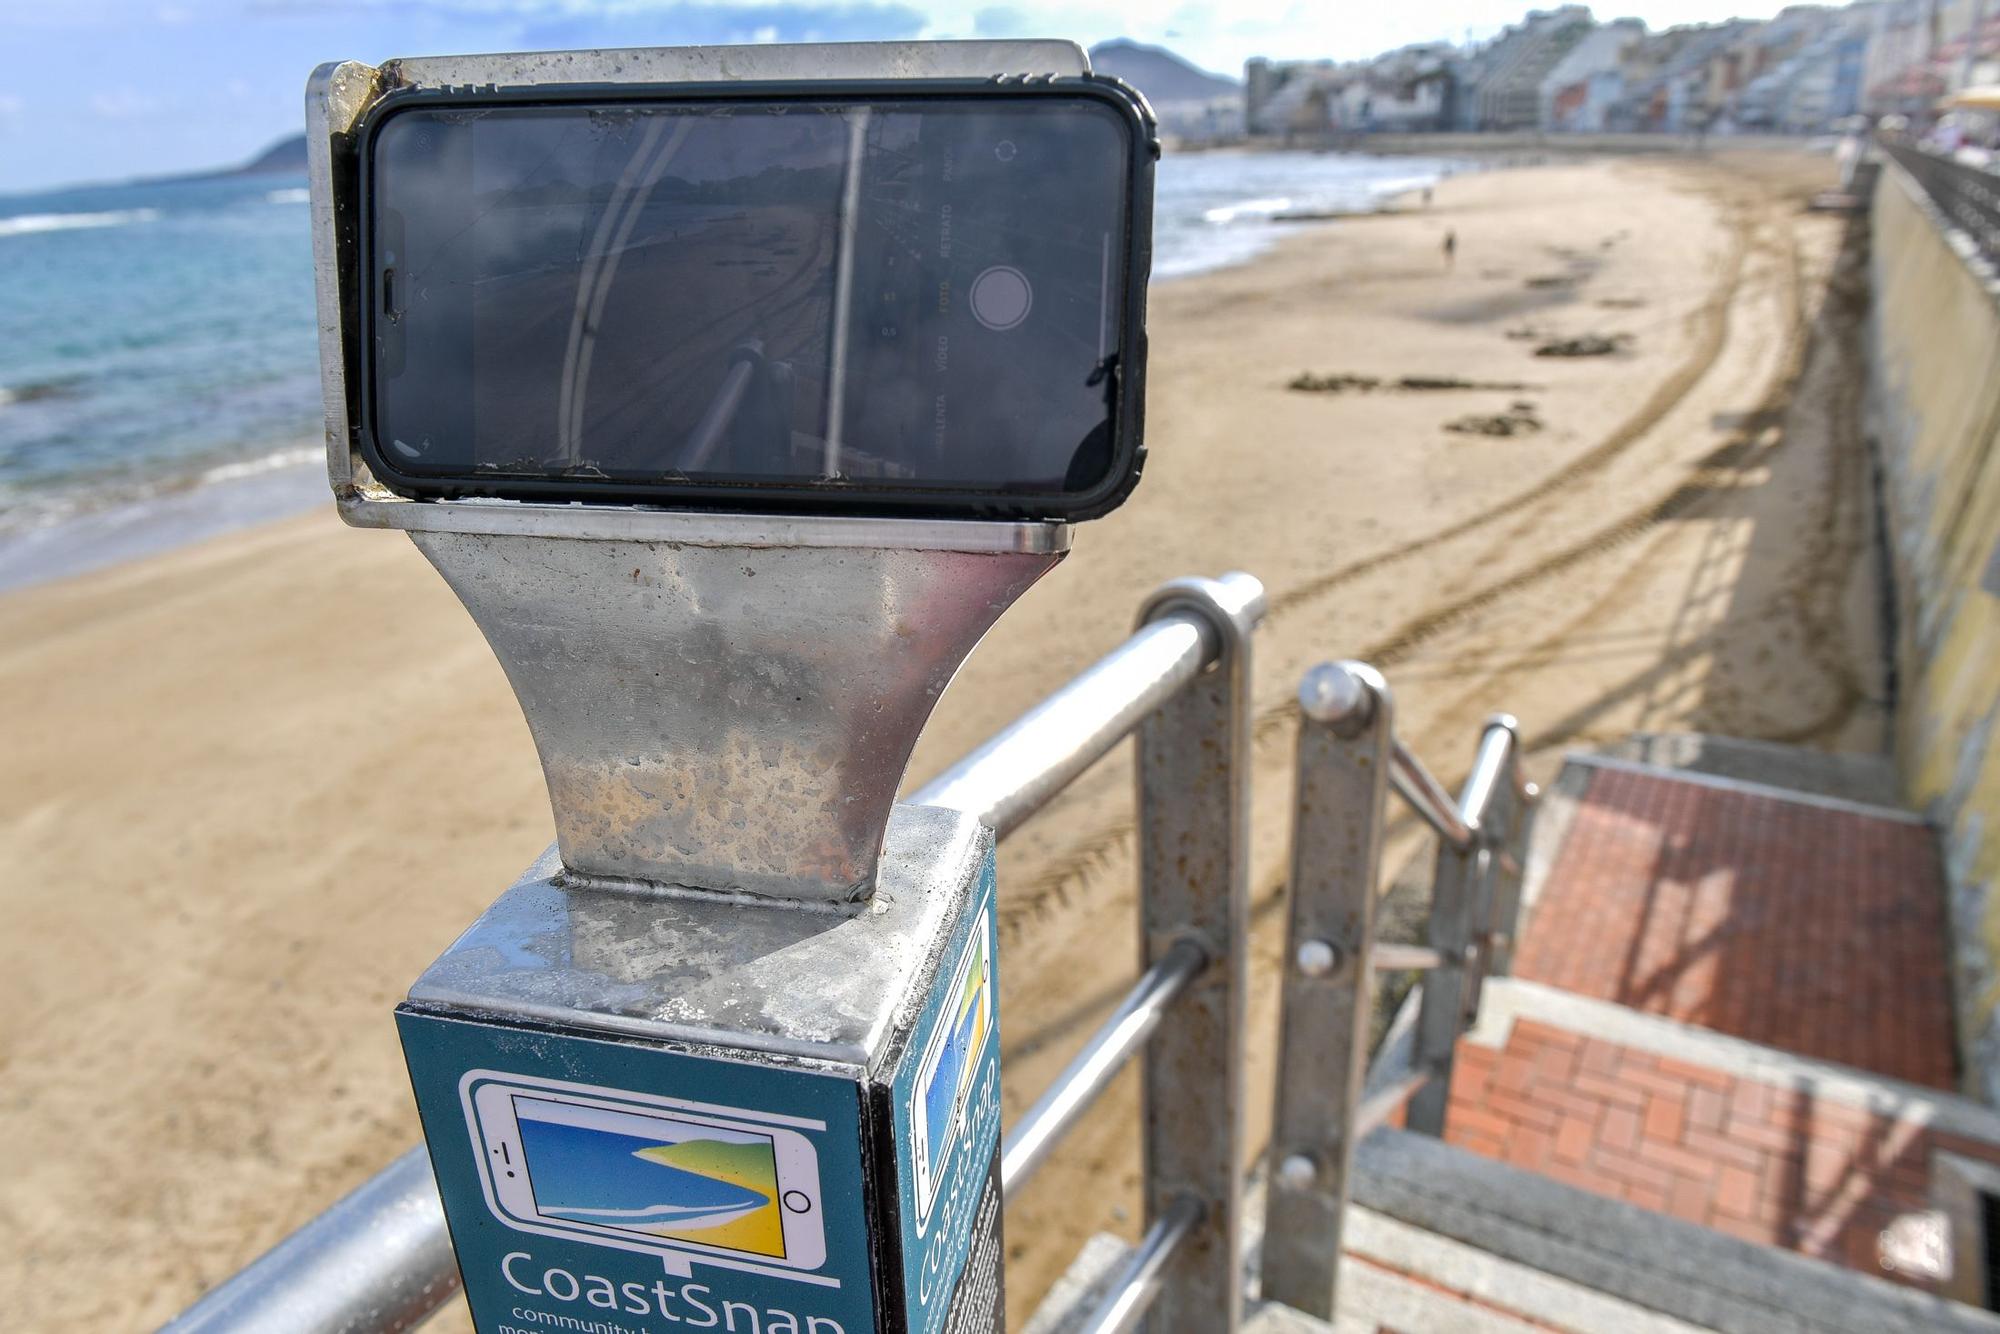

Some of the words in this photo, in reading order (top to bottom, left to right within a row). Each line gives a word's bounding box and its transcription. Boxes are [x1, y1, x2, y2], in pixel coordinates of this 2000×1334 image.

[940, 204, 953, 259] RETRATO
[939, 282, 950, 313] FOTO
[934, 336, 949, 373] VÍDEO
[920, 1057, 995, 1306] CoastSnap
